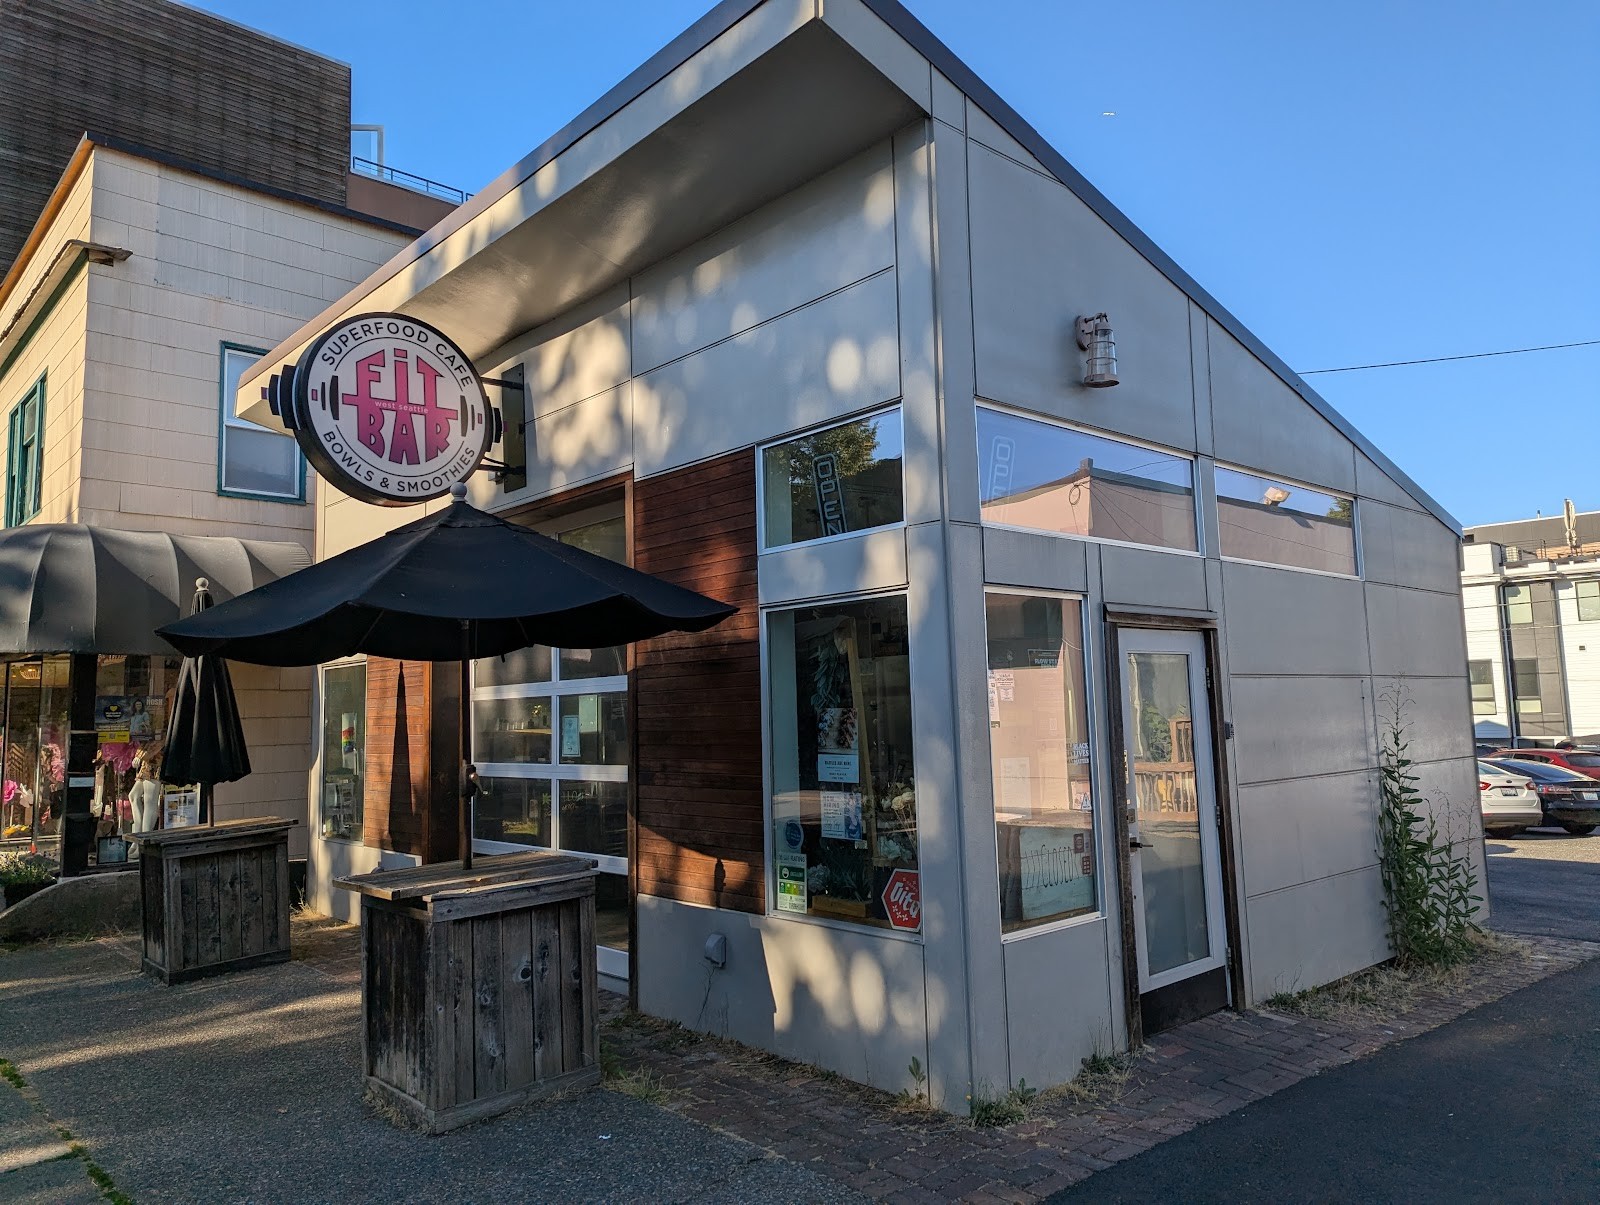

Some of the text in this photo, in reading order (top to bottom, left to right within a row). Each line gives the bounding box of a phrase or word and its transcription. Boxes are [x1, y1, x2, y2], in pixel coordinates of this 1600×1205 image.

[321, 321, 473, 388] SUPERFOOD CAFE
[357, 404, 450, 466] BAR
[375, 401, 429, 414] west seattle
[323, 430, 475, 493] BOWLS & SMOOTHIES
[817, 460, 842, 535] OPEN
[1073, 742, 1089, 750] BLACK
[1073, 749, 1089, 757] LIVES
